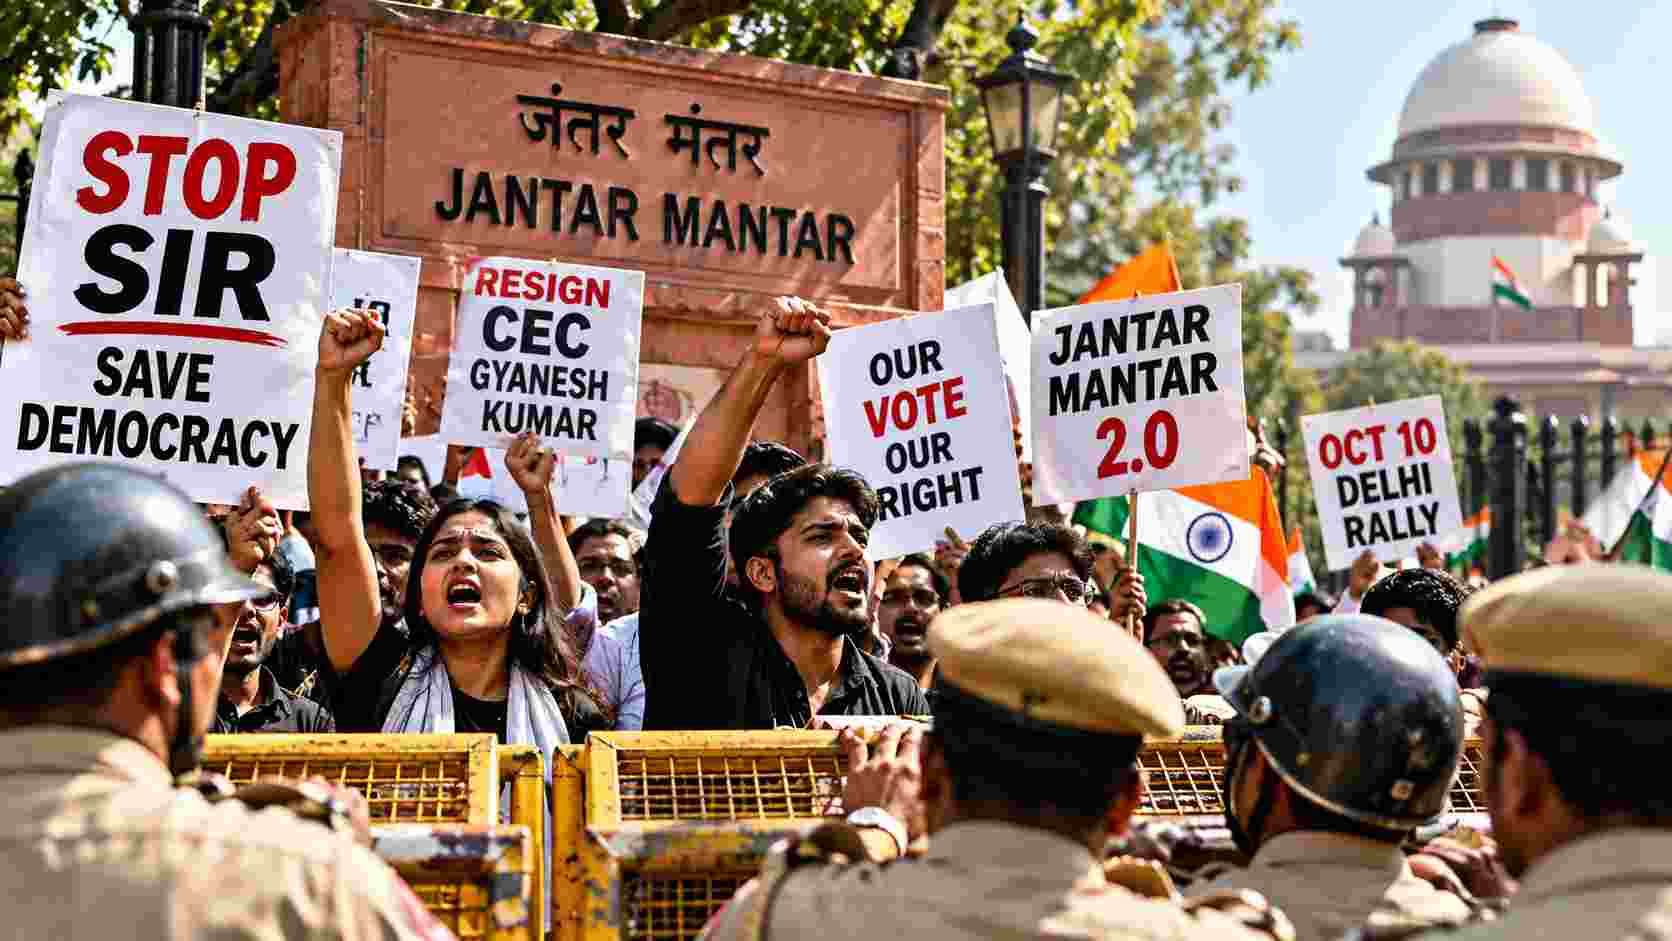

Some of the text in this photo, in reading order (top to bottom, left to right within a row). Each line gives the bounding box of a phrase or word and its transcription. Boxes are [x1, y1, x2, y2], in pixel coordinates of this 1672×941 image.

[516, 82, 770, 176] जंतर मंतर
[76, 130, 297, 222] STOP
[435, 168, 856, 264] JANTAR MANTAR
[73, 224, 276, 321] SIR
[474, 267, 611, 309] RESIGN
[482, 305, 592, 359] CEC
[1049, 304, 1211, 366] JANTAR
[93, 346, 214, 402] SAVE
[470, 358, 609, 401] GYANESH
[869, 340, 944, 386] OUR
[1049, 351, 1218, 416] MANTAR
[481, 400, 598, 441] KUMAR
[864, 376, 968, 438] VOTE
[17, 402, 299, 470] DEMOCRACY
[886, 431, 954, 475] OUR
[1096, 409, 1179, 479] 2.0
[1319, 417, 1437, 470] OCT 10
[879, 466, 983, 521] RIGHT
[1336, 462, 1433, 508] DELHI
[1343, 502, 1440, 549] RALLY
